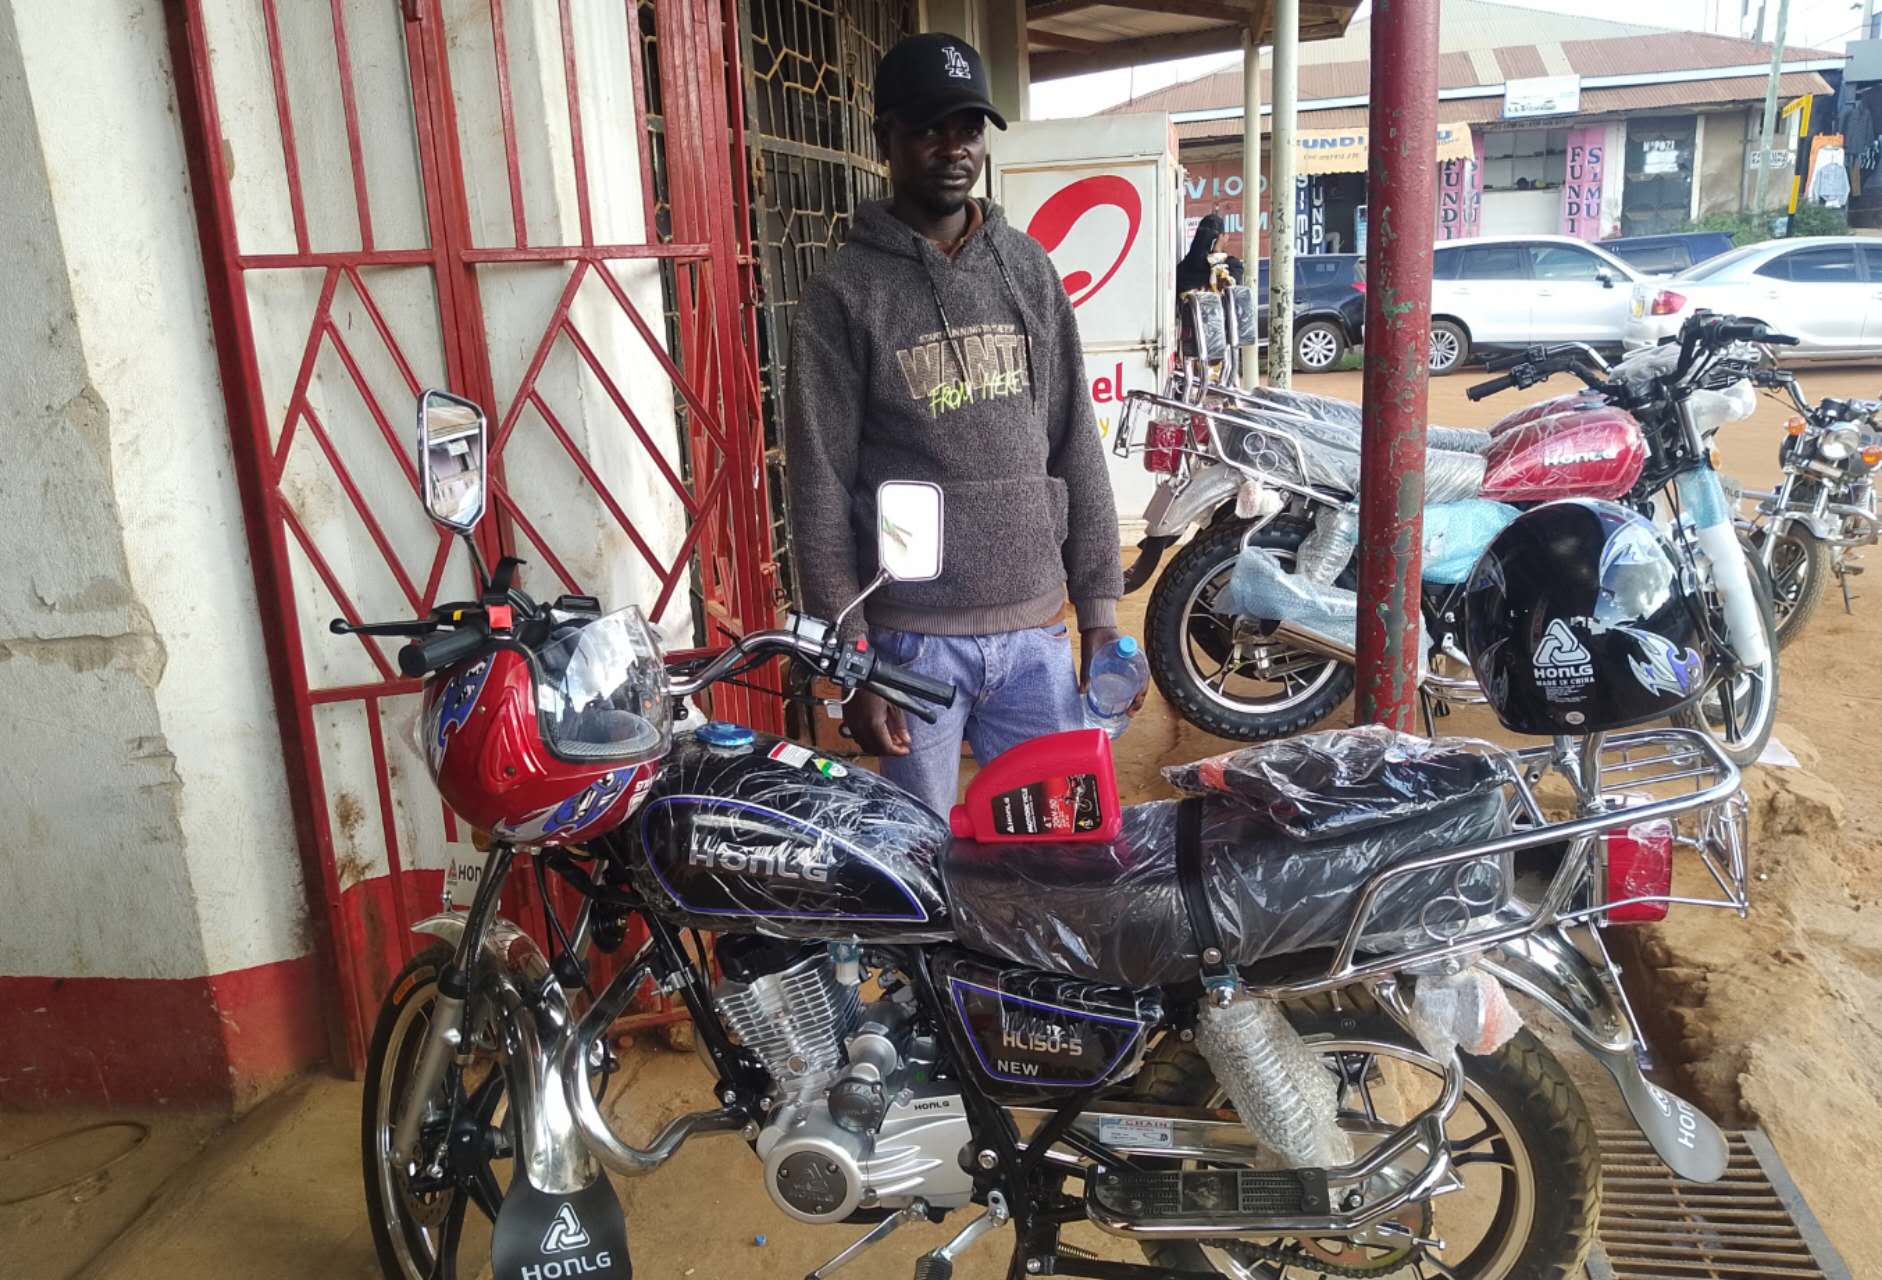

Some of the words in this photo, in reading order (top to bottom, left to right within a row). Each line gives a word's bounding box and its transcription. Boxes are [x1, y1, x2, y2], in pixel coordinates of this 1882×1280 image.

[1297, 136, 1364, 149] UNDI
[1567, 146, 1584, 233] FUNDI
[1533, 663, 1594, 679] HONLG
[688, 845, 828, 882] HONLG
[997, 1059, 1039, 1077] NEW
[521, 1251, 611, 1280] HONLG
